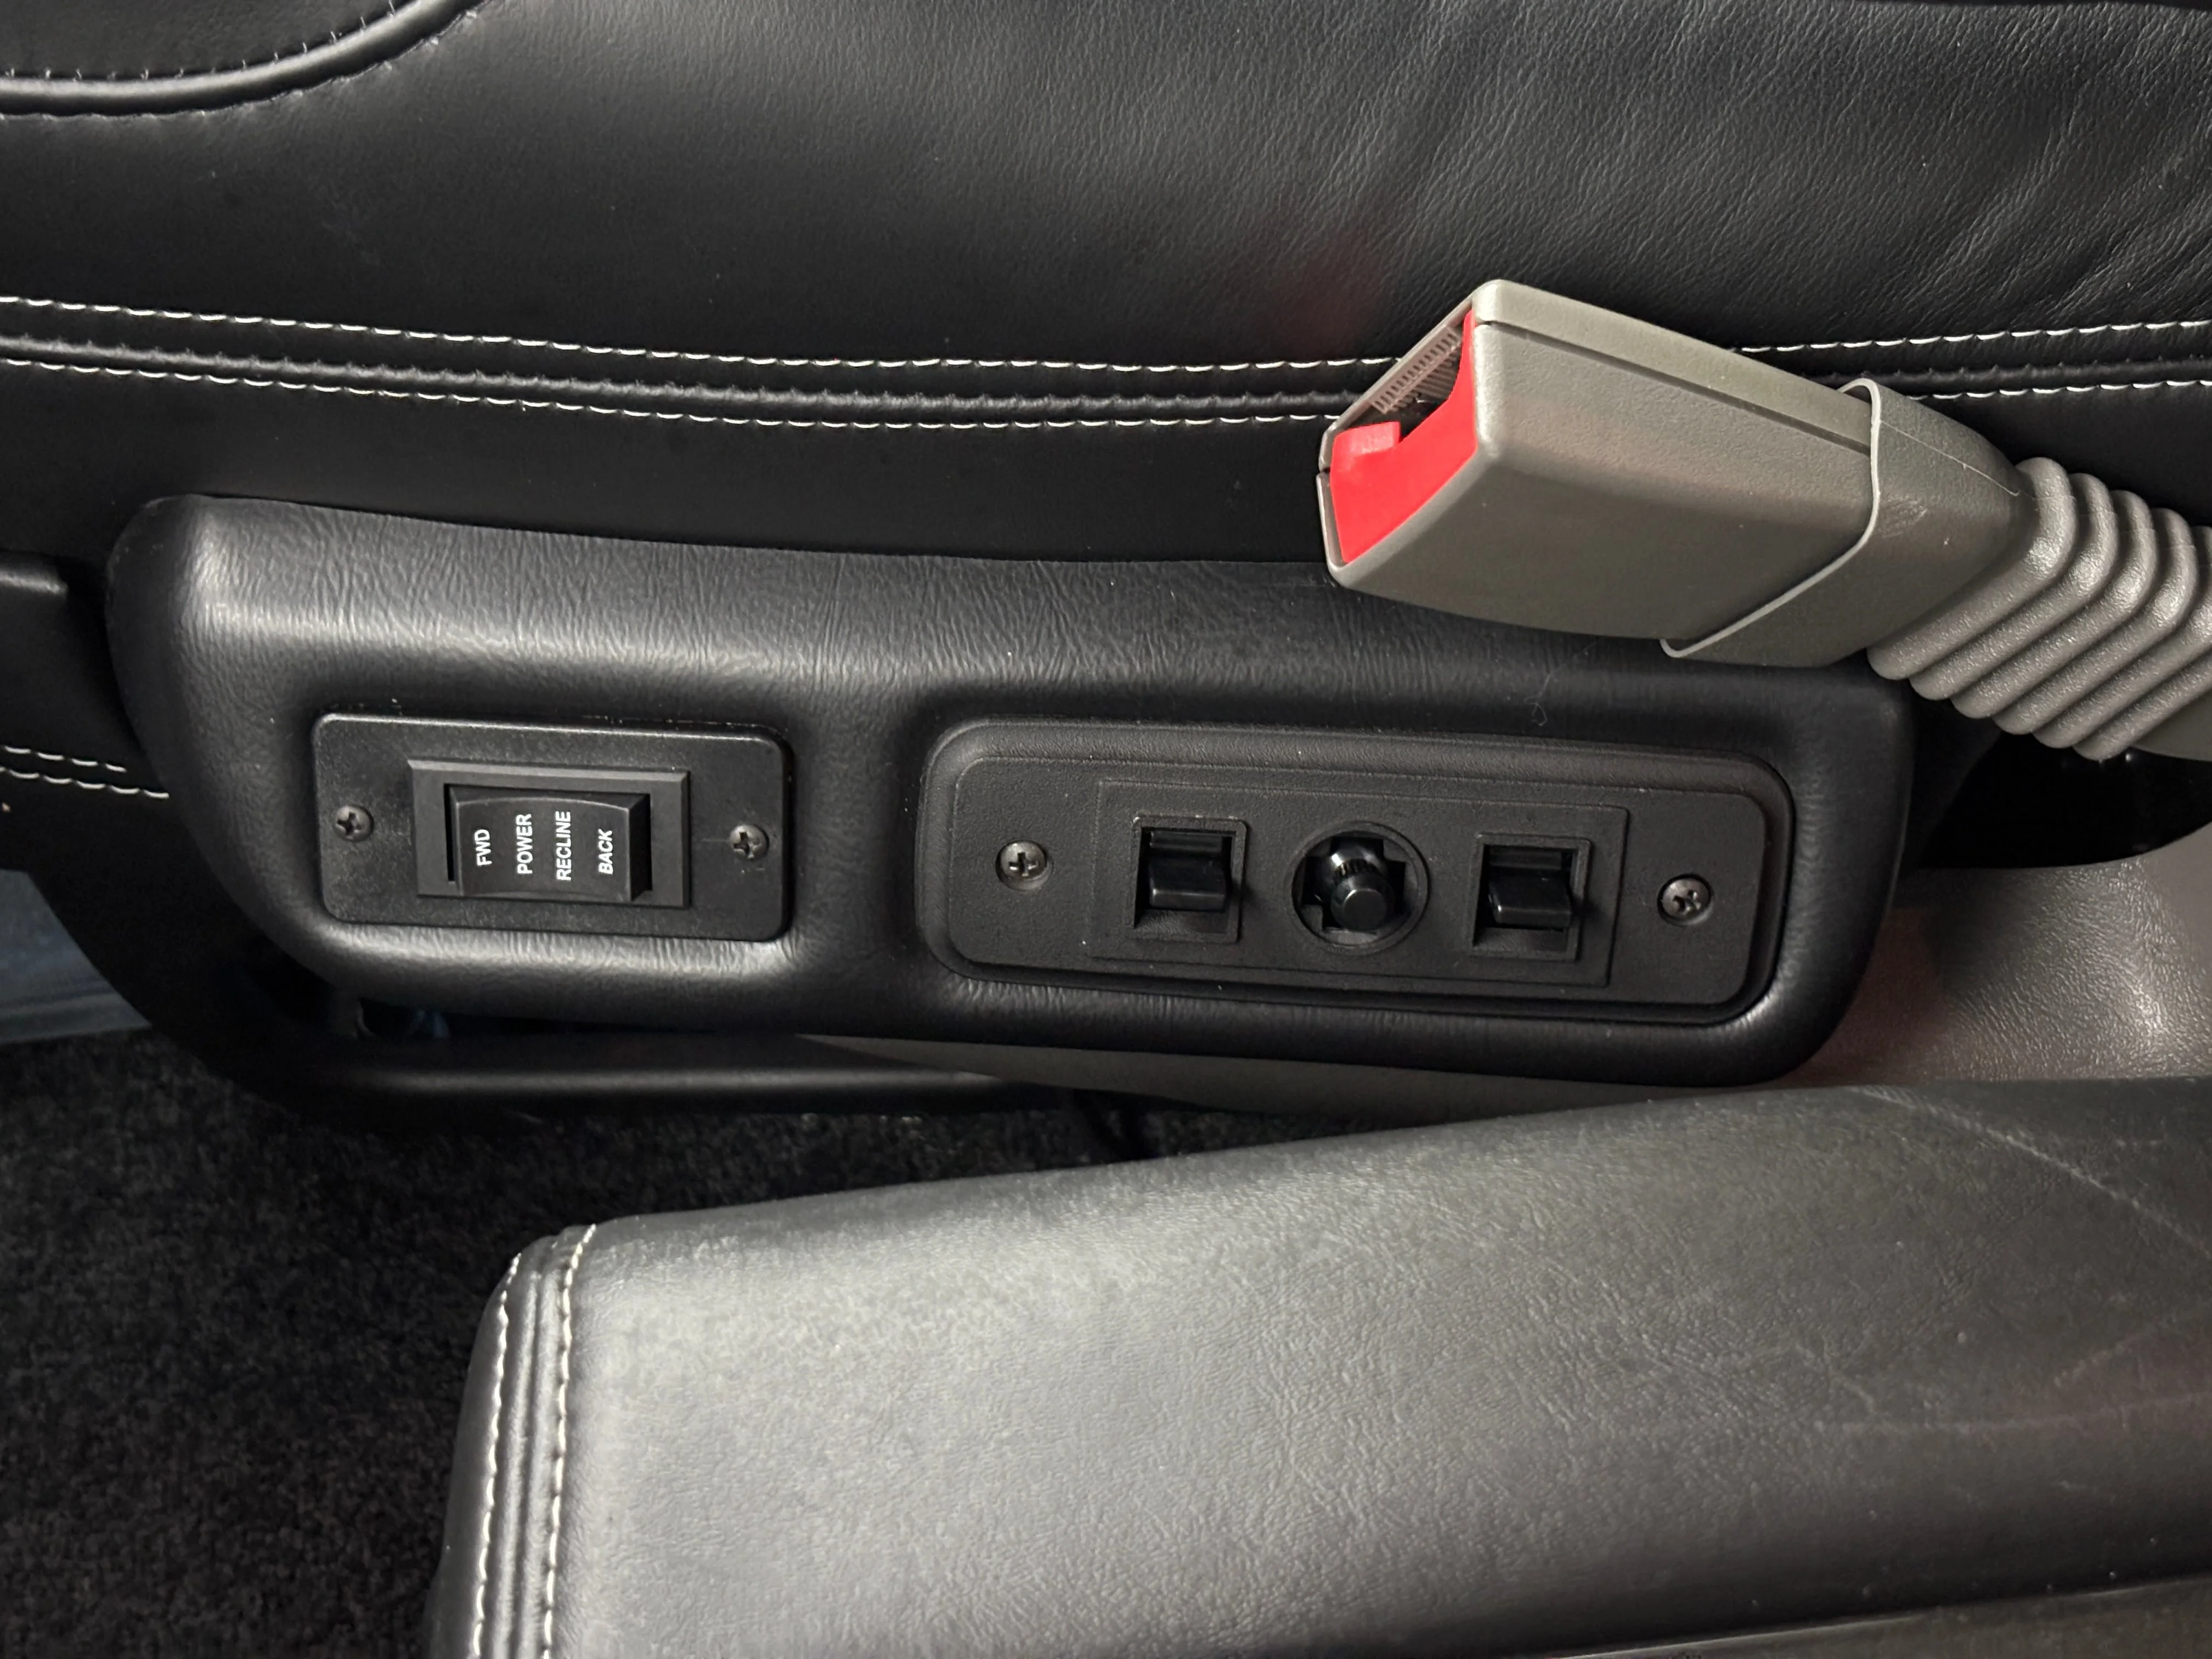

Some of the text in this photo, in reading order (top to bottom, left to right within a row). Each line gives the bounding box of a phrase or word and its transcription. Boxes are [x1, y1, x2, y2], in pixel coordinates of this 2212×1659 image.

[474, 829, 492, 866] FWD
[516, 814, 533, 874] POWER
[555, 811, 571, 881] RECLINE
[597, 829, 613, 874] BACK
